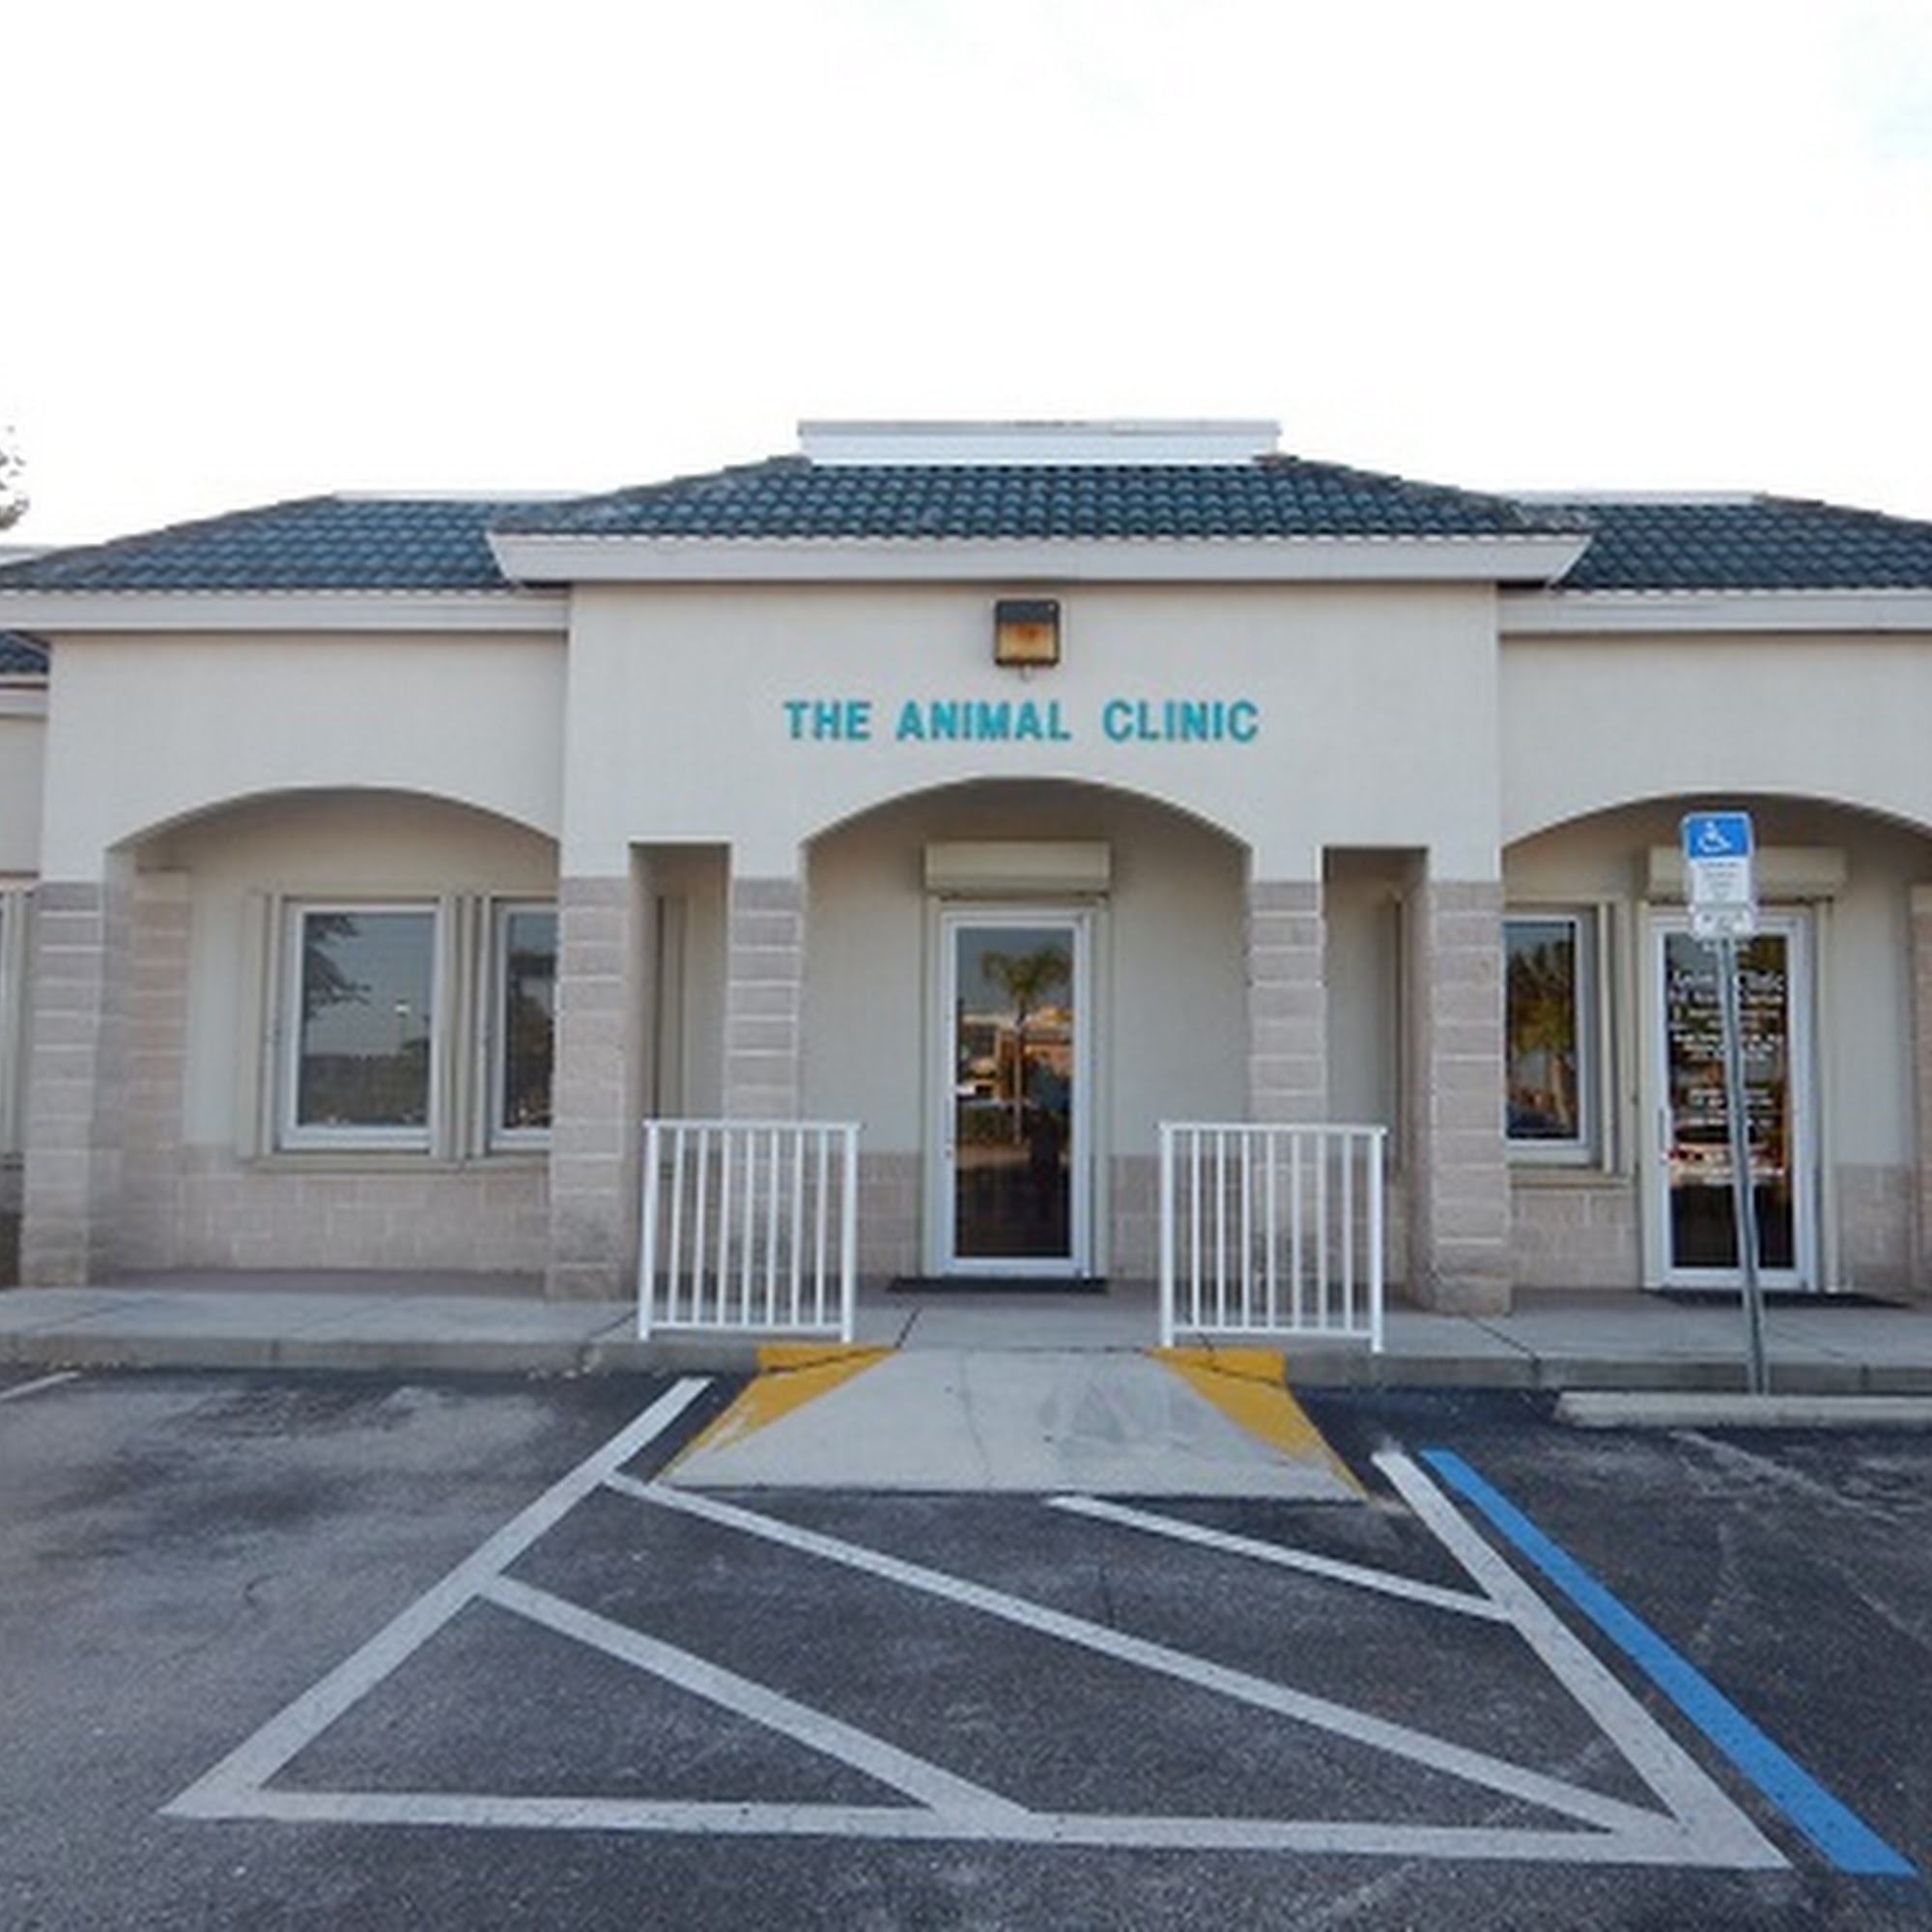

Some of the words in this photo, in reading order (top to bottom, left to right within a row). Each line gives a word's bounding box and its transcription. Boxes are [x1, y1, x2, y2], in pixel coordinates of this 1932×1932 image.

[784, 698, 871, 743] THE
[895, 698, 1070, 743] ANIMAL
[1101, 698, 1260, 744] CLINIC
